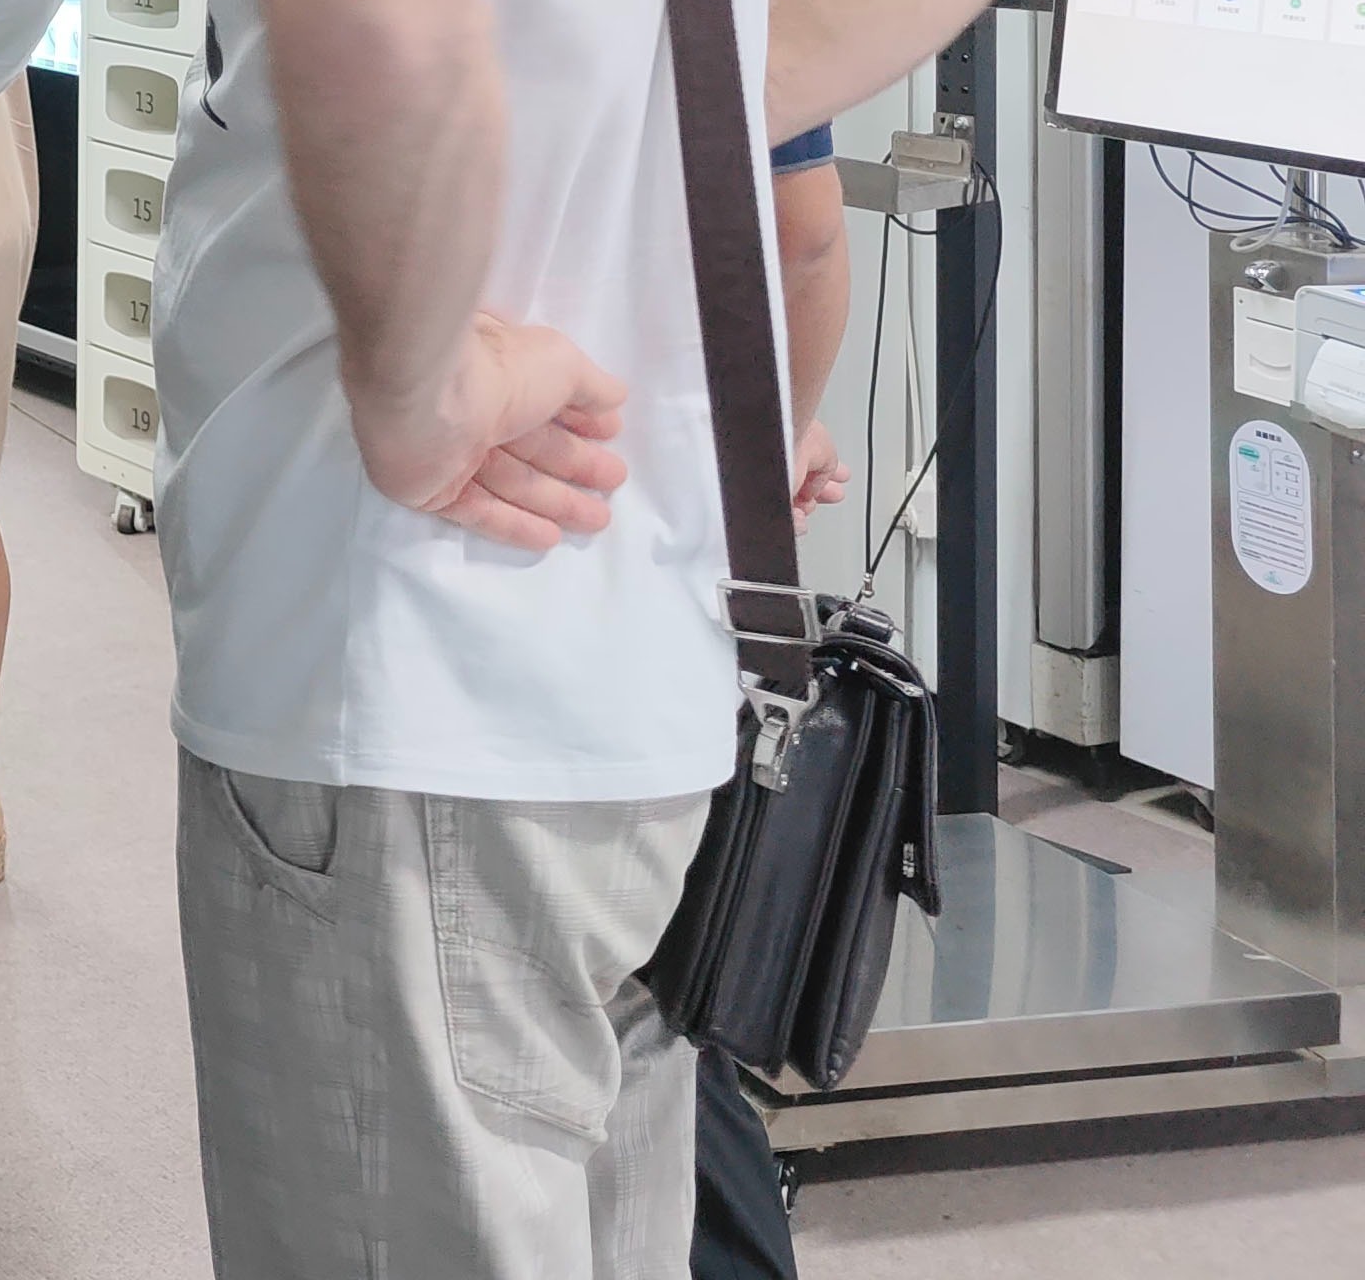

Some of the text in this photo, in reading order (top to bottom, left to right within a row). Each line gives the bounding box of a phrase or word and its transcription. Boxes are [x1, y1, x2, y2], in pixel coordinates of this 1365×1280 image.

[134, 90, 155, 115] 13
[133, 197, 152, 223] 15
[130, 300, 149, 325] 17
[131, 407, 151, 432] 19
